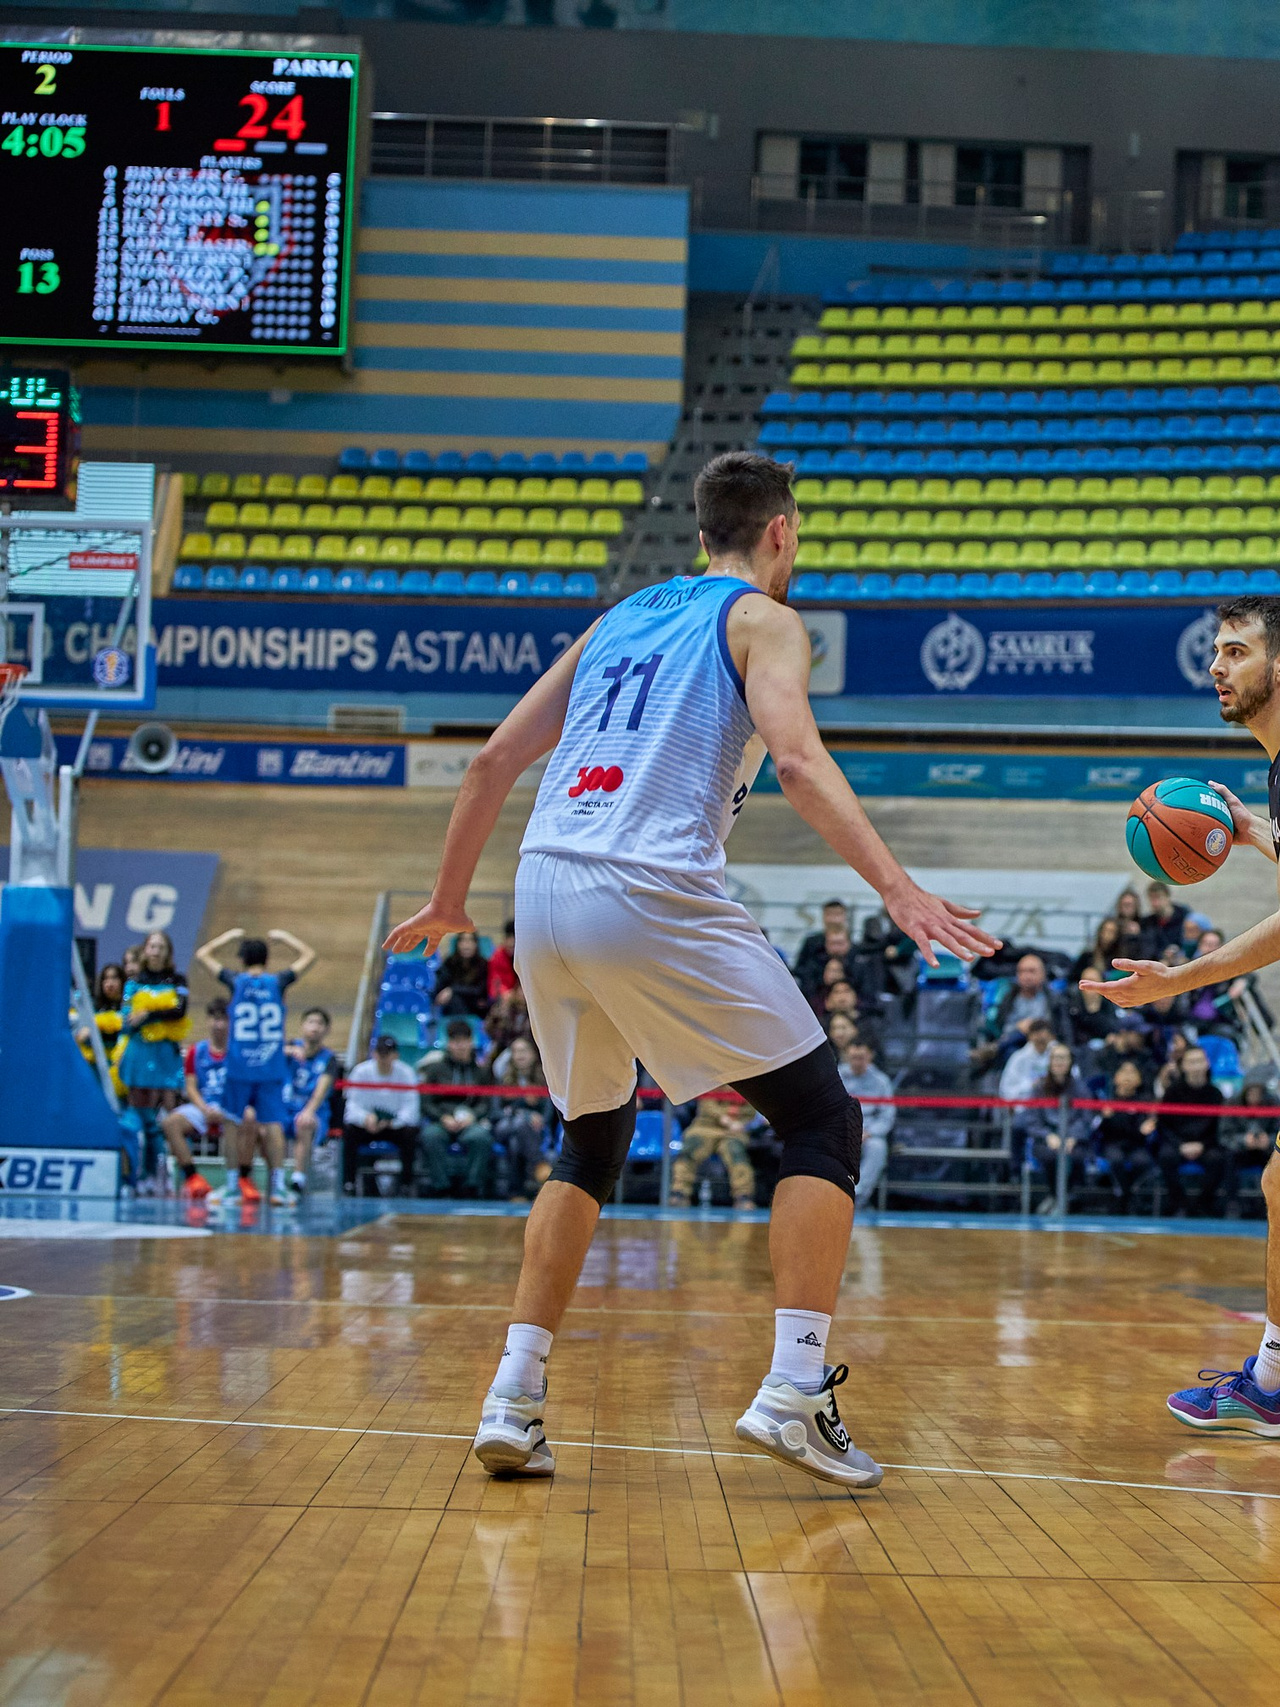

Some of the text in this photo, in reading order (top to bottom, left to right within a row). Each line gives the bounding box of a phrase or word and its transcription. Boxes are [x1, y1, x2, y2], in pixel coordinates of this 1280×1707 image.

[21, 51, 73, 64] PERIOD
[272, 59, 354, 78] PARMA
[33, 64, 57, 95] 2
[154, 101, 172, 131] 1
[235, 93, 306, 140] 24
[1, 126, 87, 158] 4:05
[17, 262, 60, 294] 13
[64, 622, 378, 671] CHAMPIONSHIPS
[386, 629, 543, 675] ASTANA
[597, 653, 664, 732] 11
[568, 765, 624, 798] 300
[233, 1002, 283, 1041] 22
